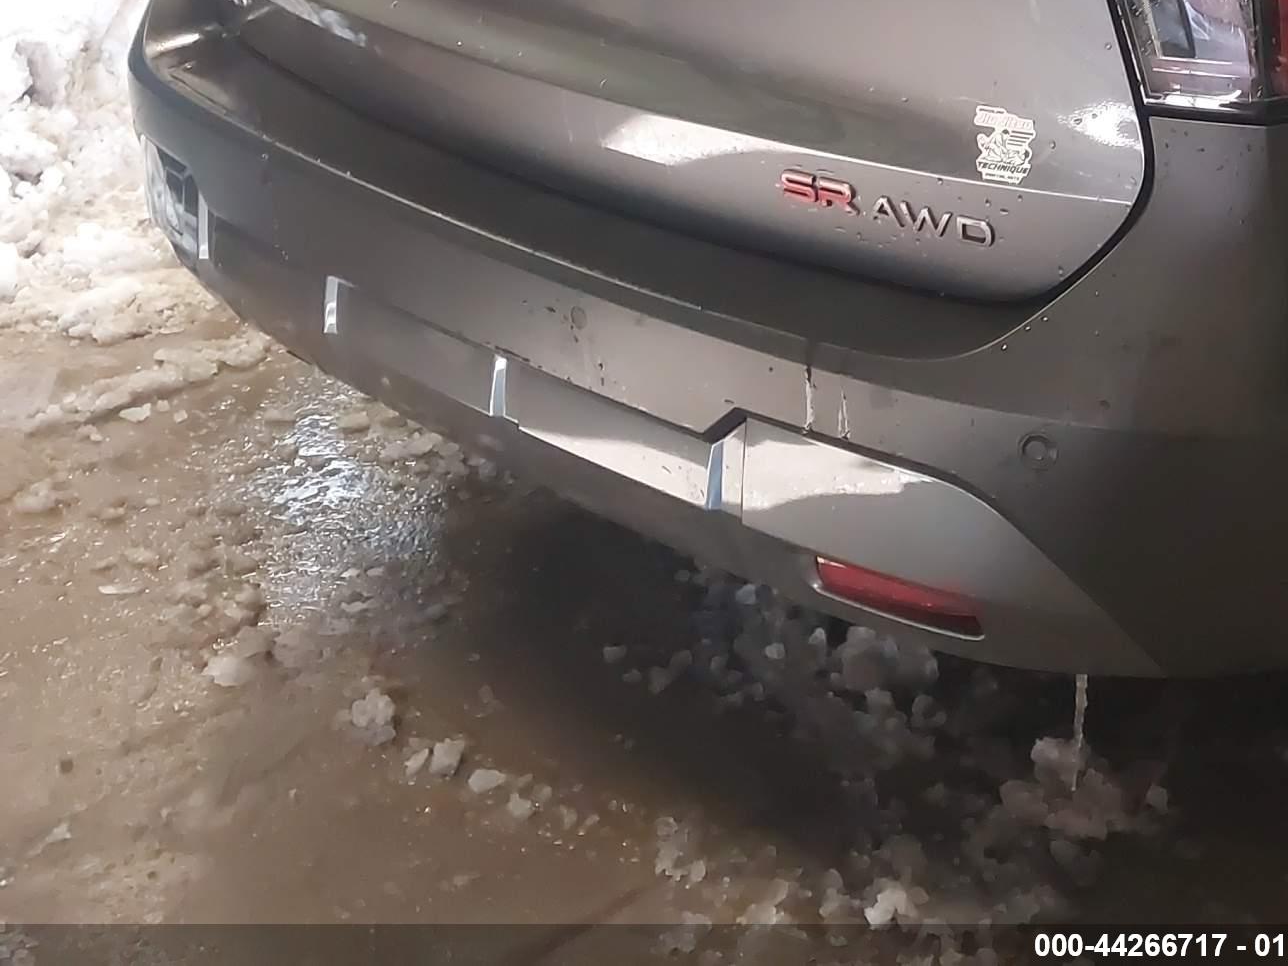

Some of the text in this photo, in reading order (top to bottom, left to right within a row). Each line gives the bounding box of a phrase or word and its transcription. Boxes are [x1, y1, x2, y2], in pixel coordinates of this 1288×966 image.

[977, 161, 1029, 174] TECHNIQUE
[781, 169, 996, 247] SR AWD
